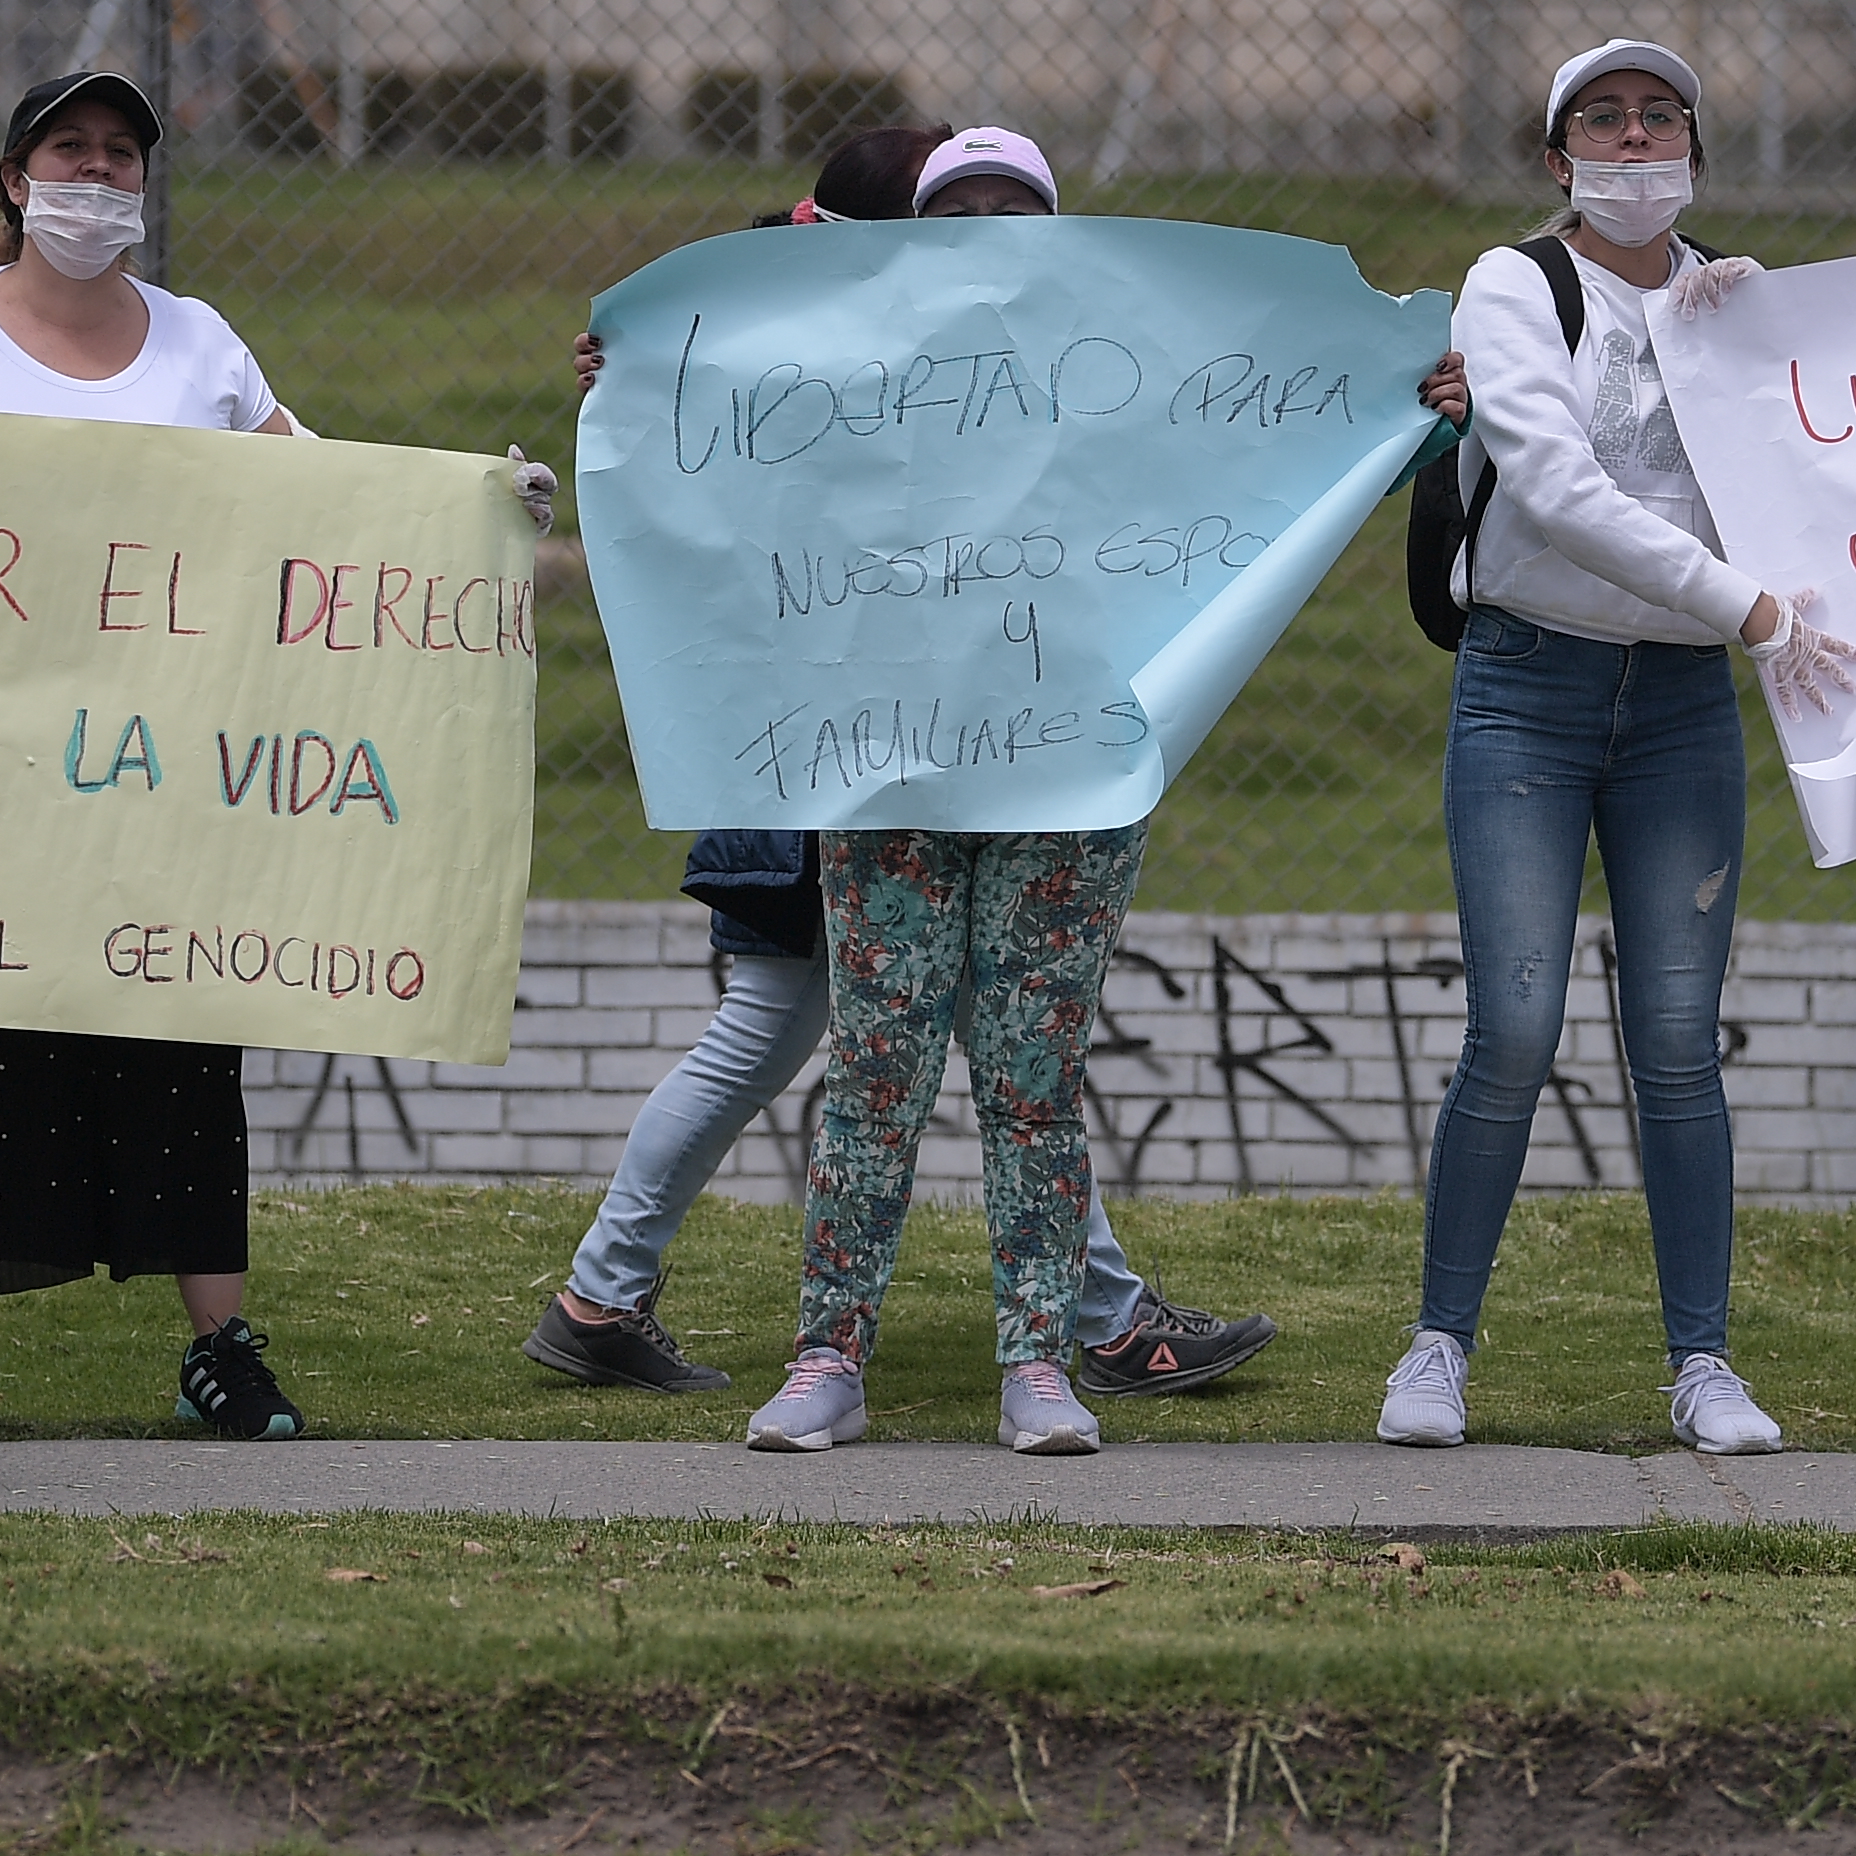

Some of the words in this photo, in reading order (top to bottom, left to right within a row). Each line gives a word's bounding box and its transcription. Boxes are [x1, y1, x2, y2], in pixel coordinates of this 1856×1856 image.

[98, 542, 207, 636] EL
[275, 557, 535, 659] DERECHO
[64, 708, 163, 794] LA
[216, 729, 400, 826] VIDA
[102, 922, 427, 1002] GENOCIDIO
